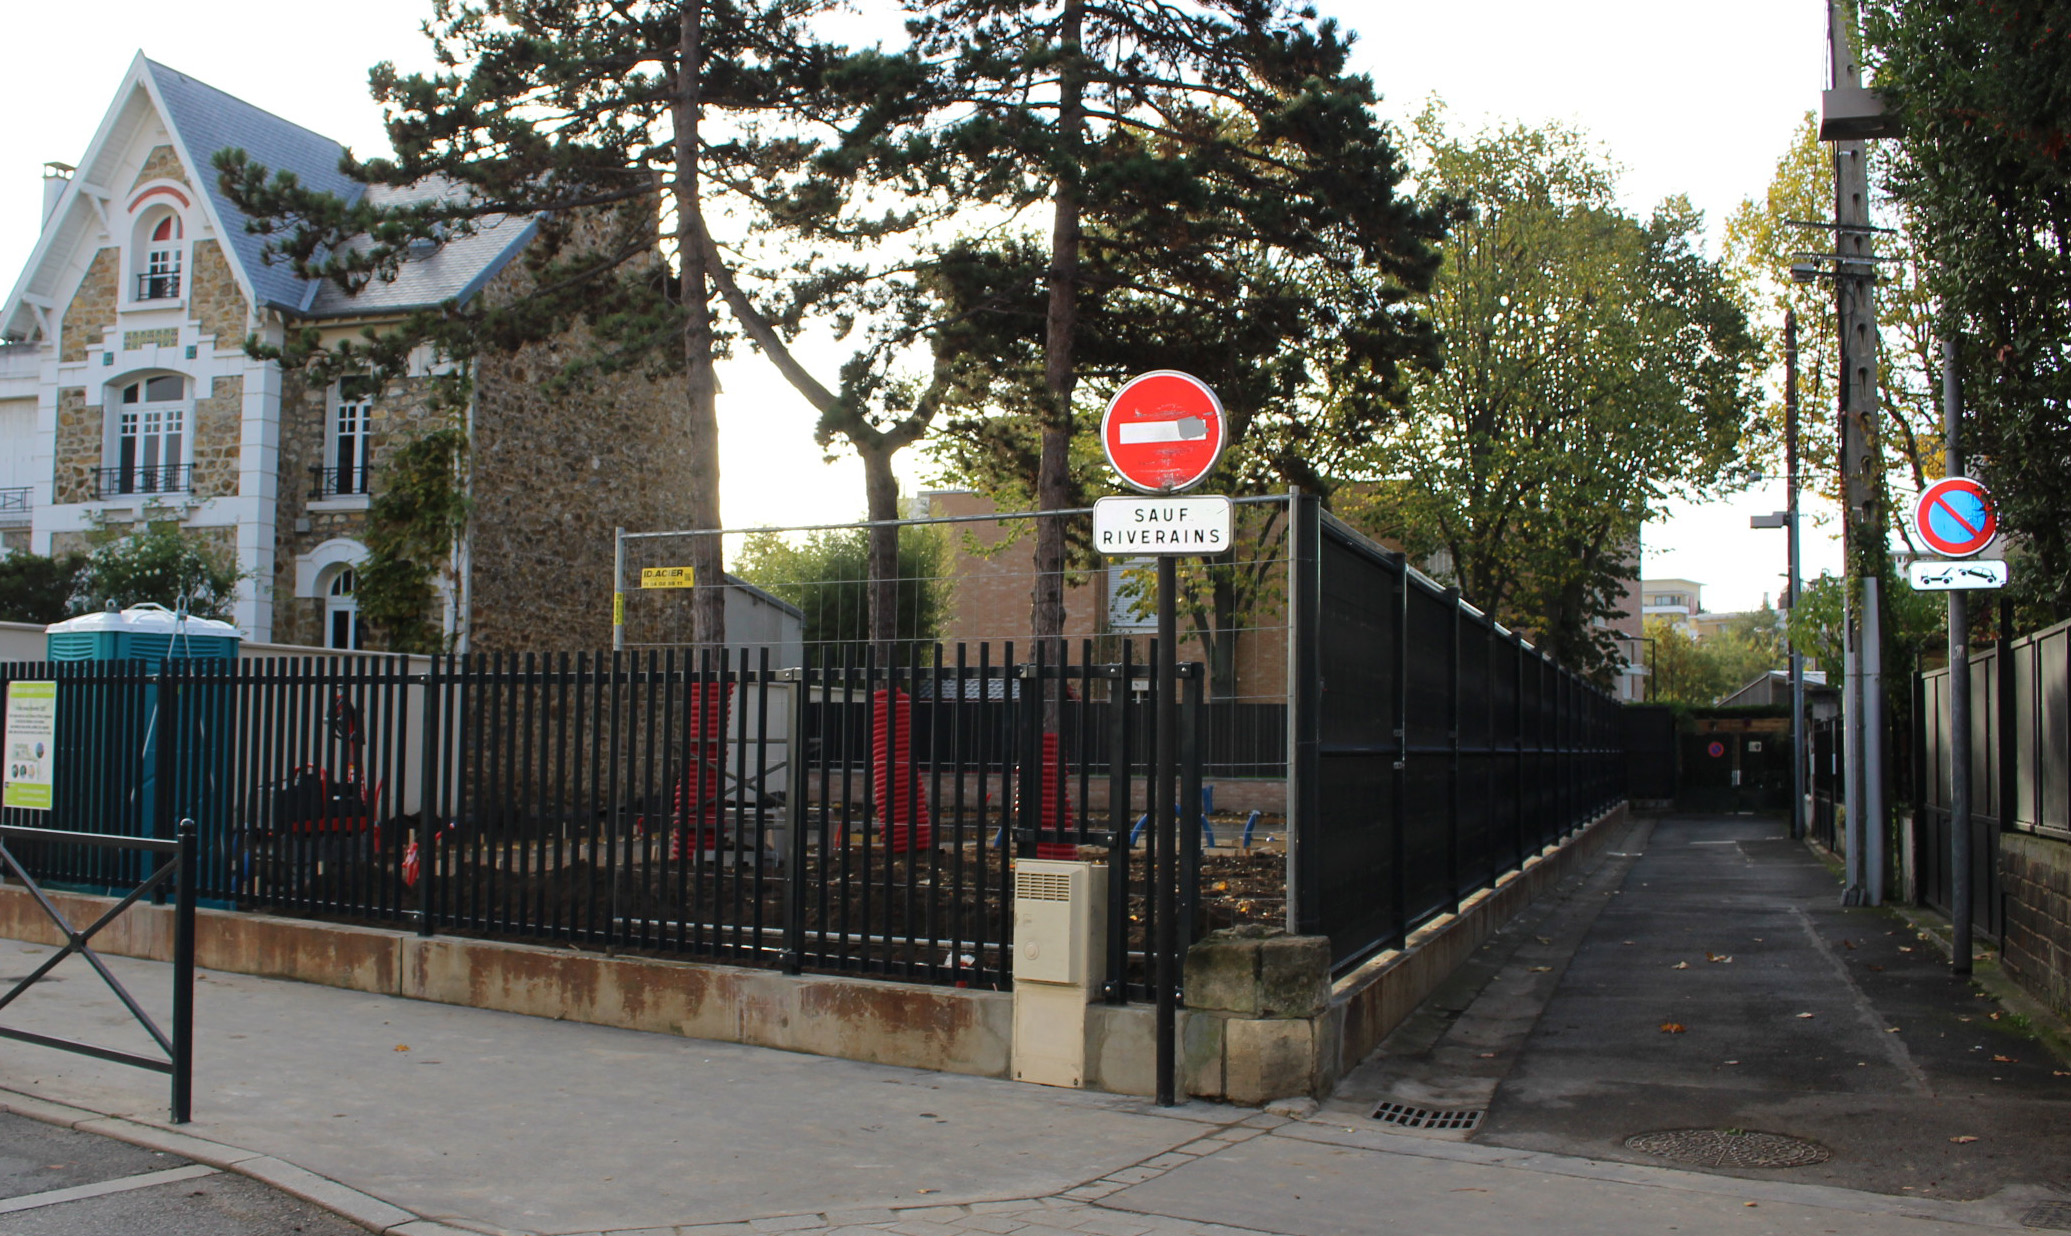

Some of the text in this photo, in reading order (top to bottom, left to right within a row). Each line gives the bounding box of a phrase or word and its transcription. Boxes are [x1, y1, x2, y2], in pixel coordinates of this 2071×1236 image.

[1134, 508, 1189, 522] SAUF
[1103, 529, 1221, 545] RIVERAINS
[643, 569, 684, 578] ID.ACIER
